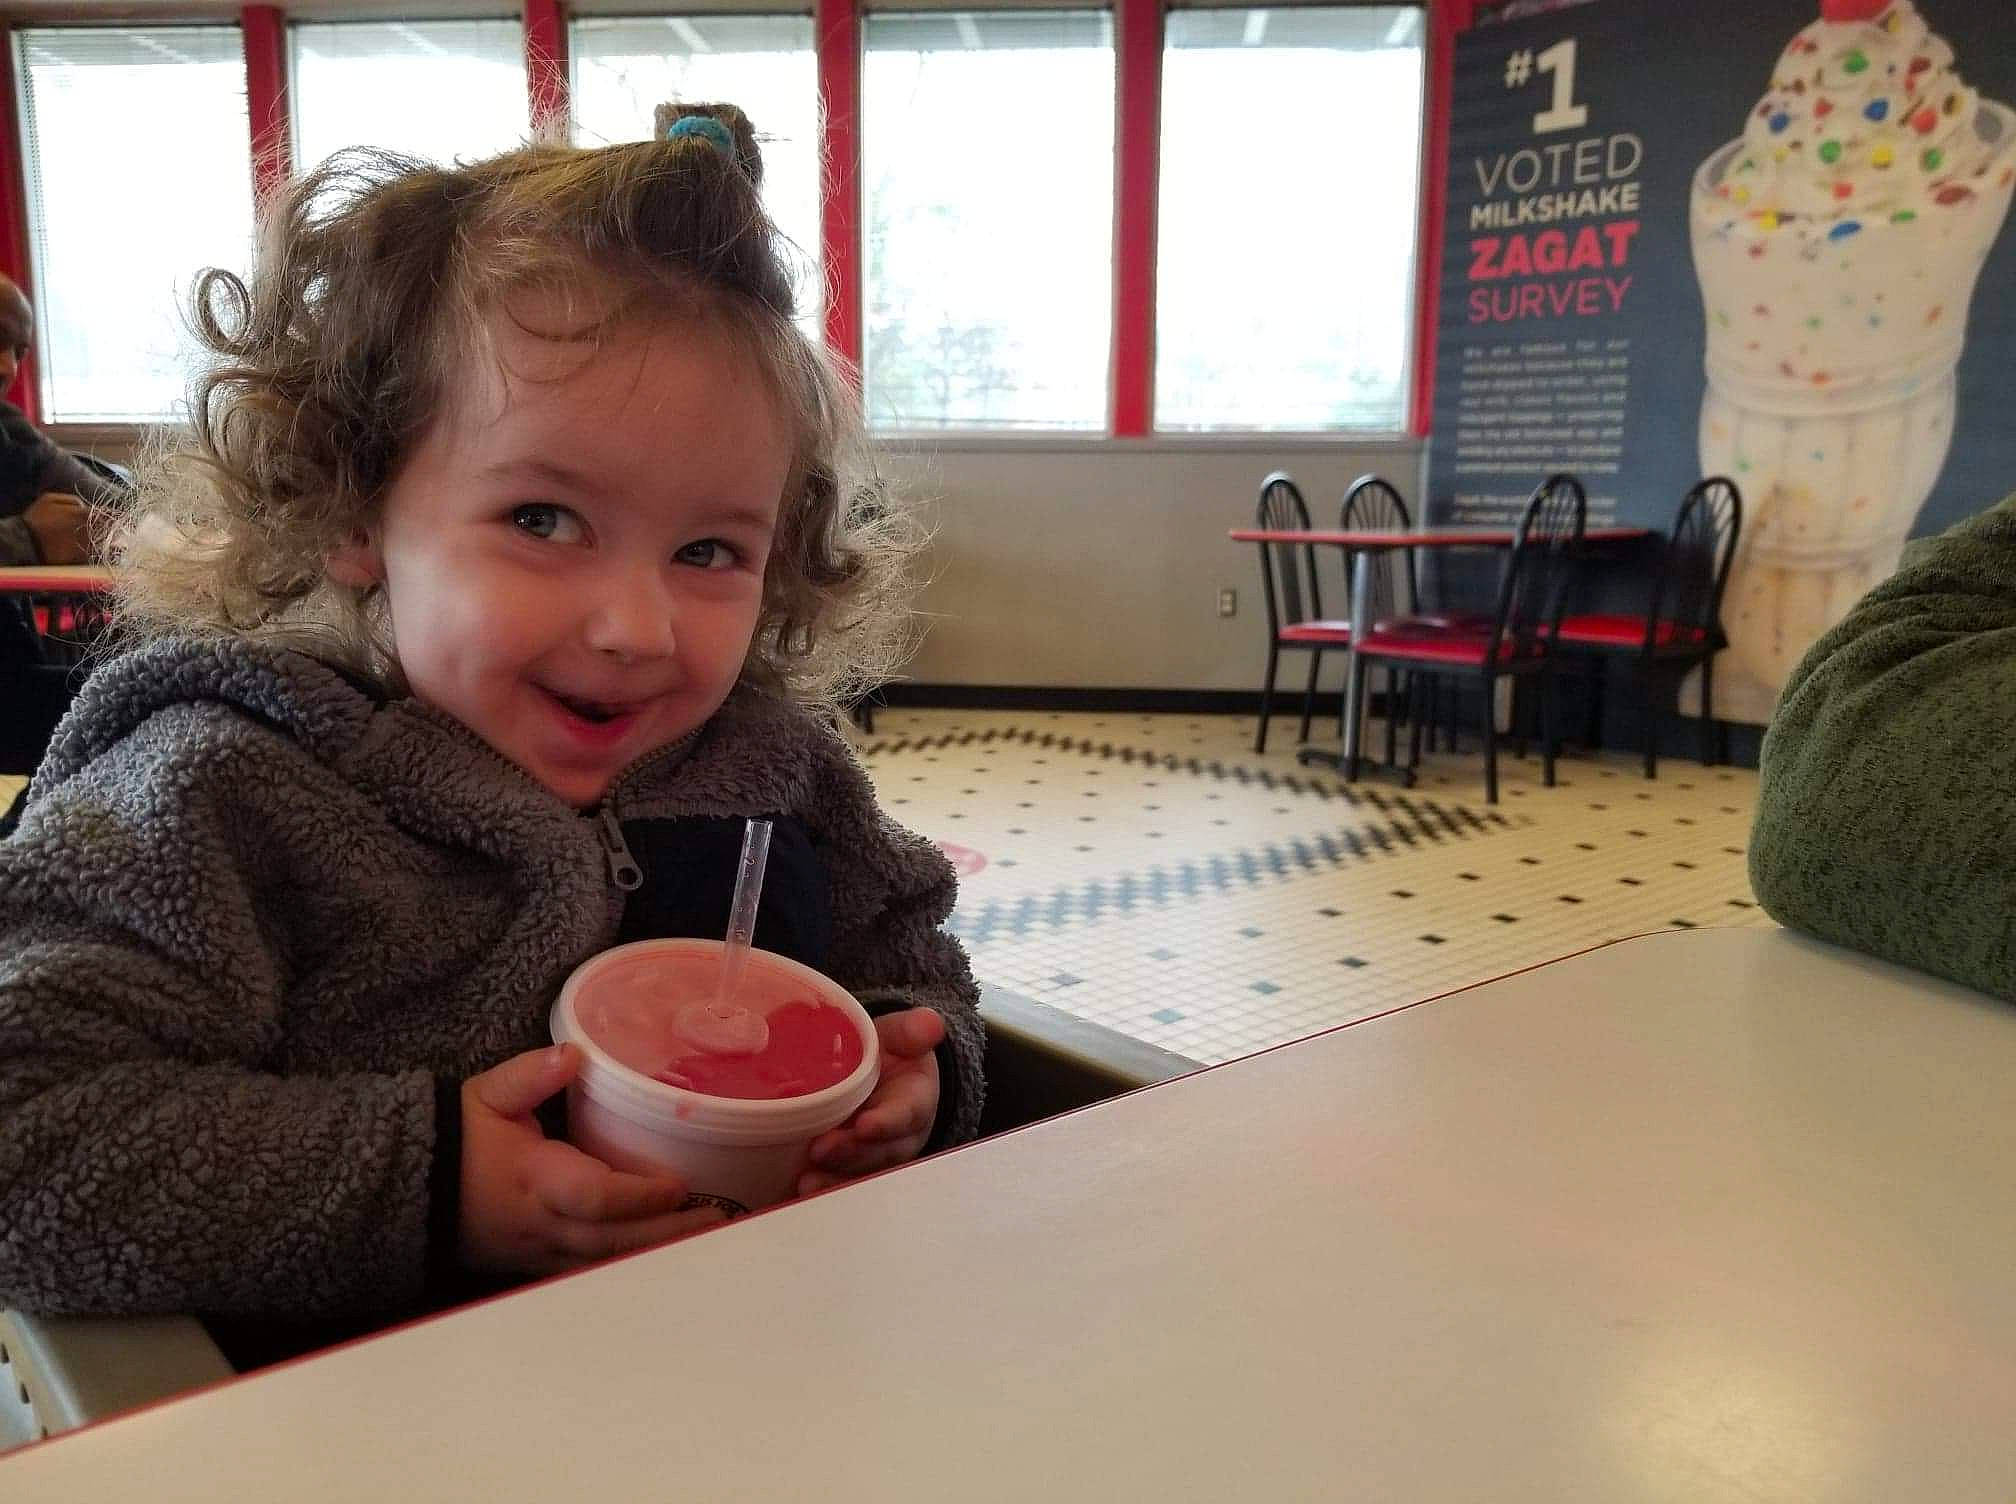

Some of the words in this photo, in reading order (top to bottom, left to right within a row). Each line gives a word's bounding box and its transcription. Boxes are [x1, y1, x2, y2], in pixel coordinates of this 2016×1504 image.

[1504, 37, 1588, 134] #1
[1475, 133, 1643, 197] VOTED
[1469, 182, 1641, 231] MILKSHAKE
[1468, 219, 1641, 281] ZAGAT
[1468, 275, 1634, 325] SURVEY
